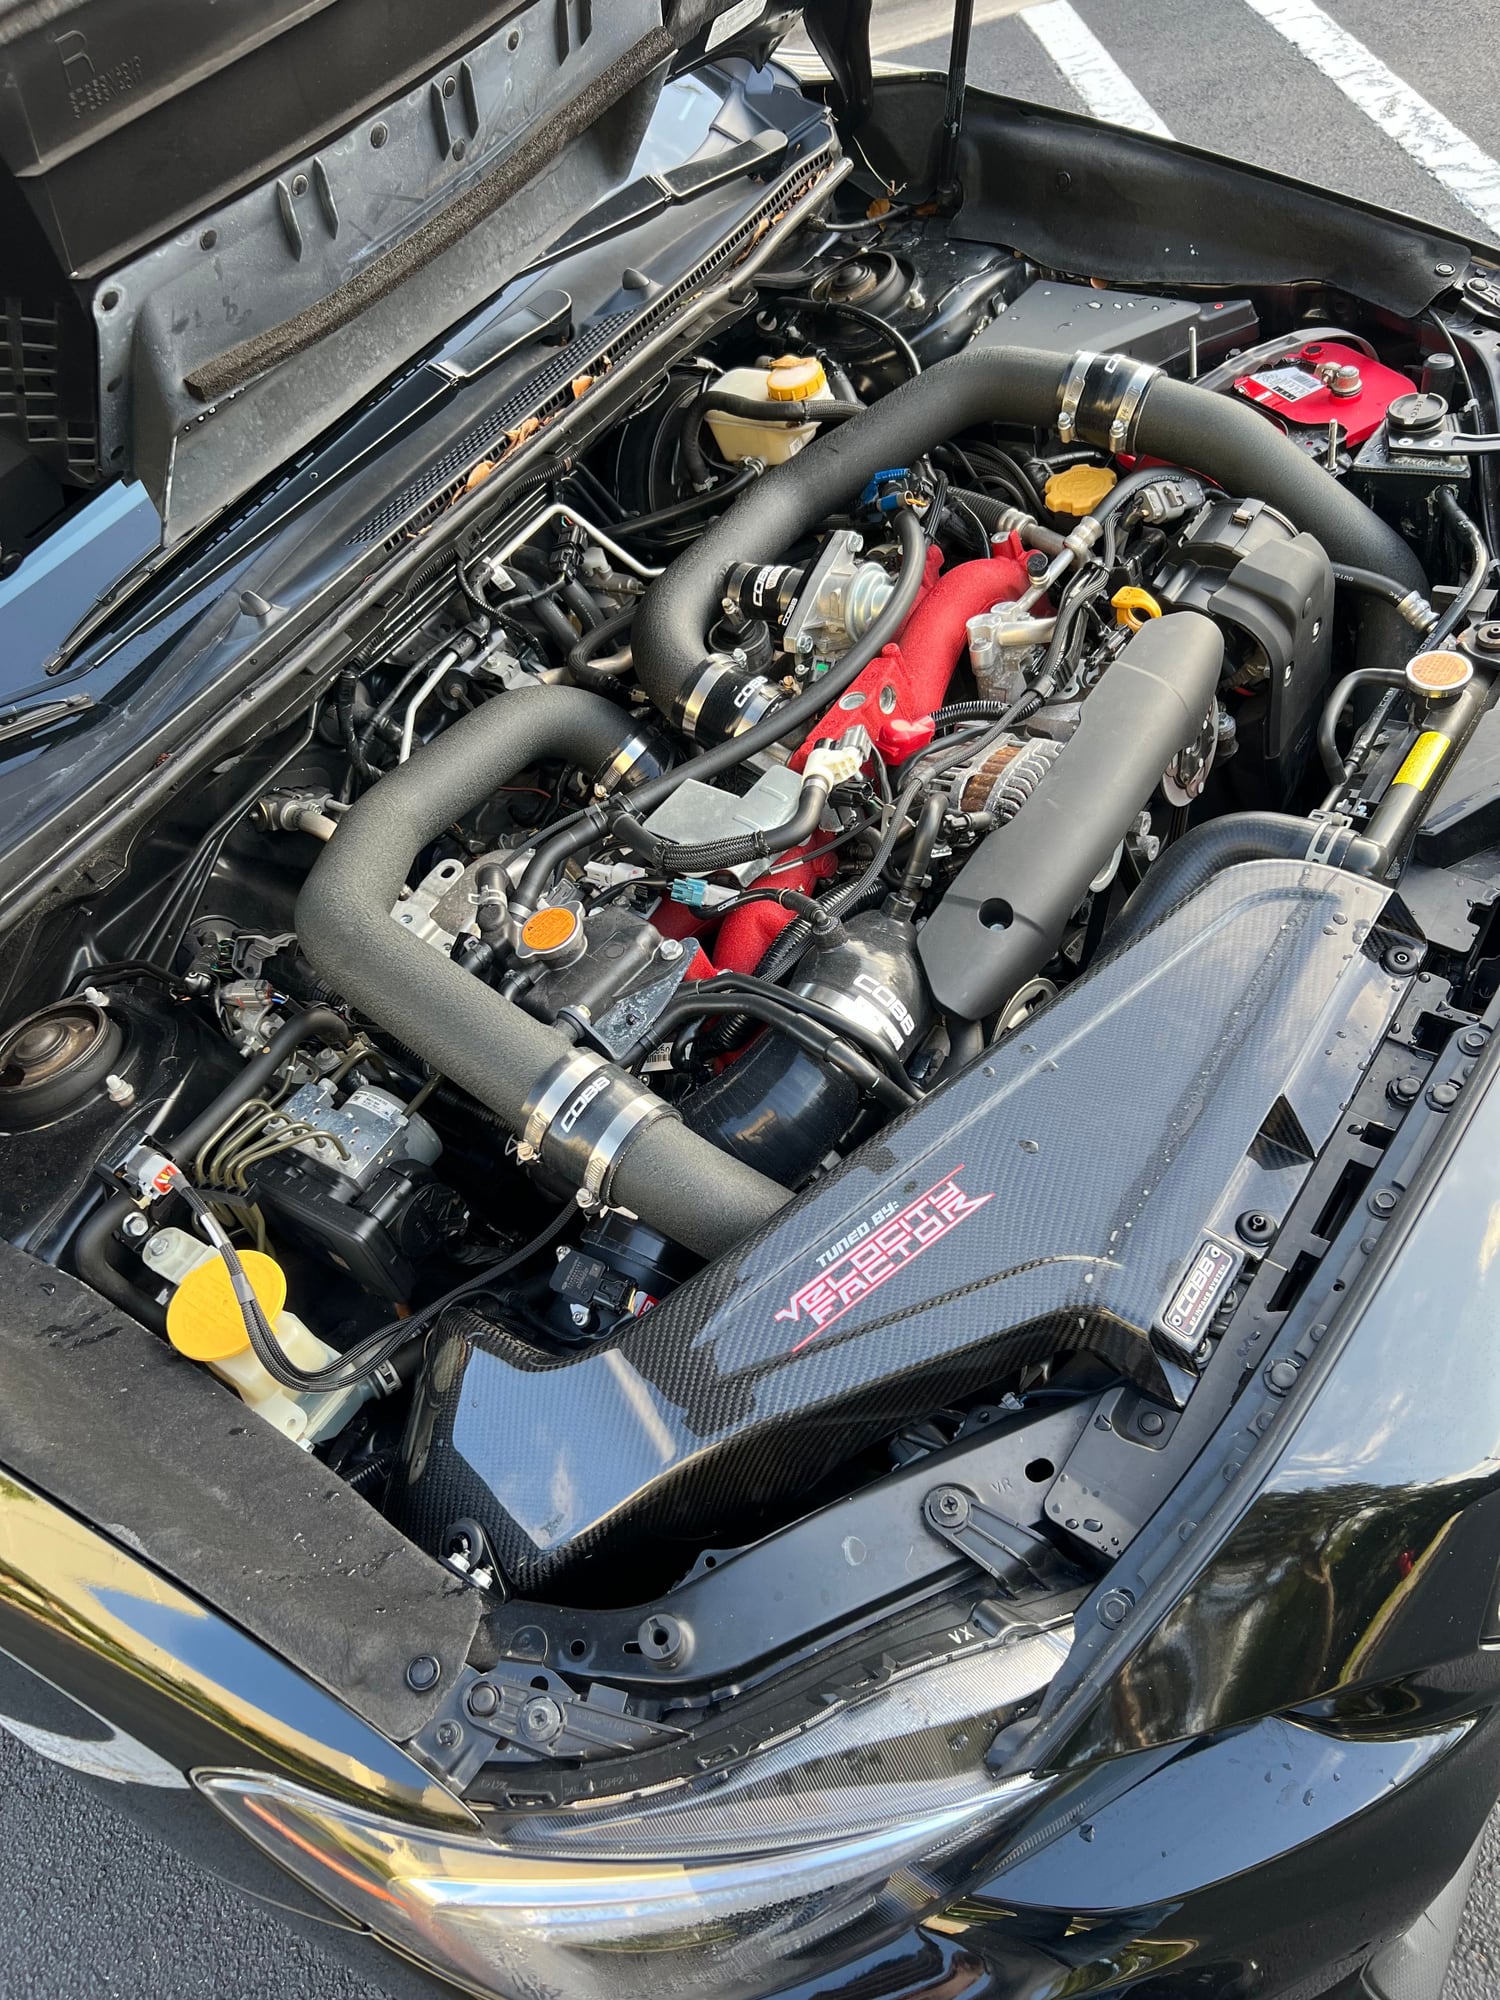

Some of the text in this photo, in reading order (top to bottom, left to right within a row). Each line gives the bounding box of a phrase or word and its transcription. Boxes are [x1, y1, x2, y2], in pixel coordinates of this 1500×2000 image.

[753, 564, 775, 607] COBB
[781, 597, 798, 626] COBB
[733, 675, 769, 709] COBB
[853, 973, 915, 1037] COBB
[560, 1075, 611, 1134] COBB
[774, 1180, 966, 1322] VELOCITY
[808, 1192, 996, 1328] FACTOR
[815, 1200, 901, 1269] TUNED BY:
[1175, 1256, 1216, 1318] COBB
[1195, 1291, 1212, 1318] INTAKE
[1208, 1264, 1226, 1292] SYSTEM
[947, 1625, 976, 1644] VX
